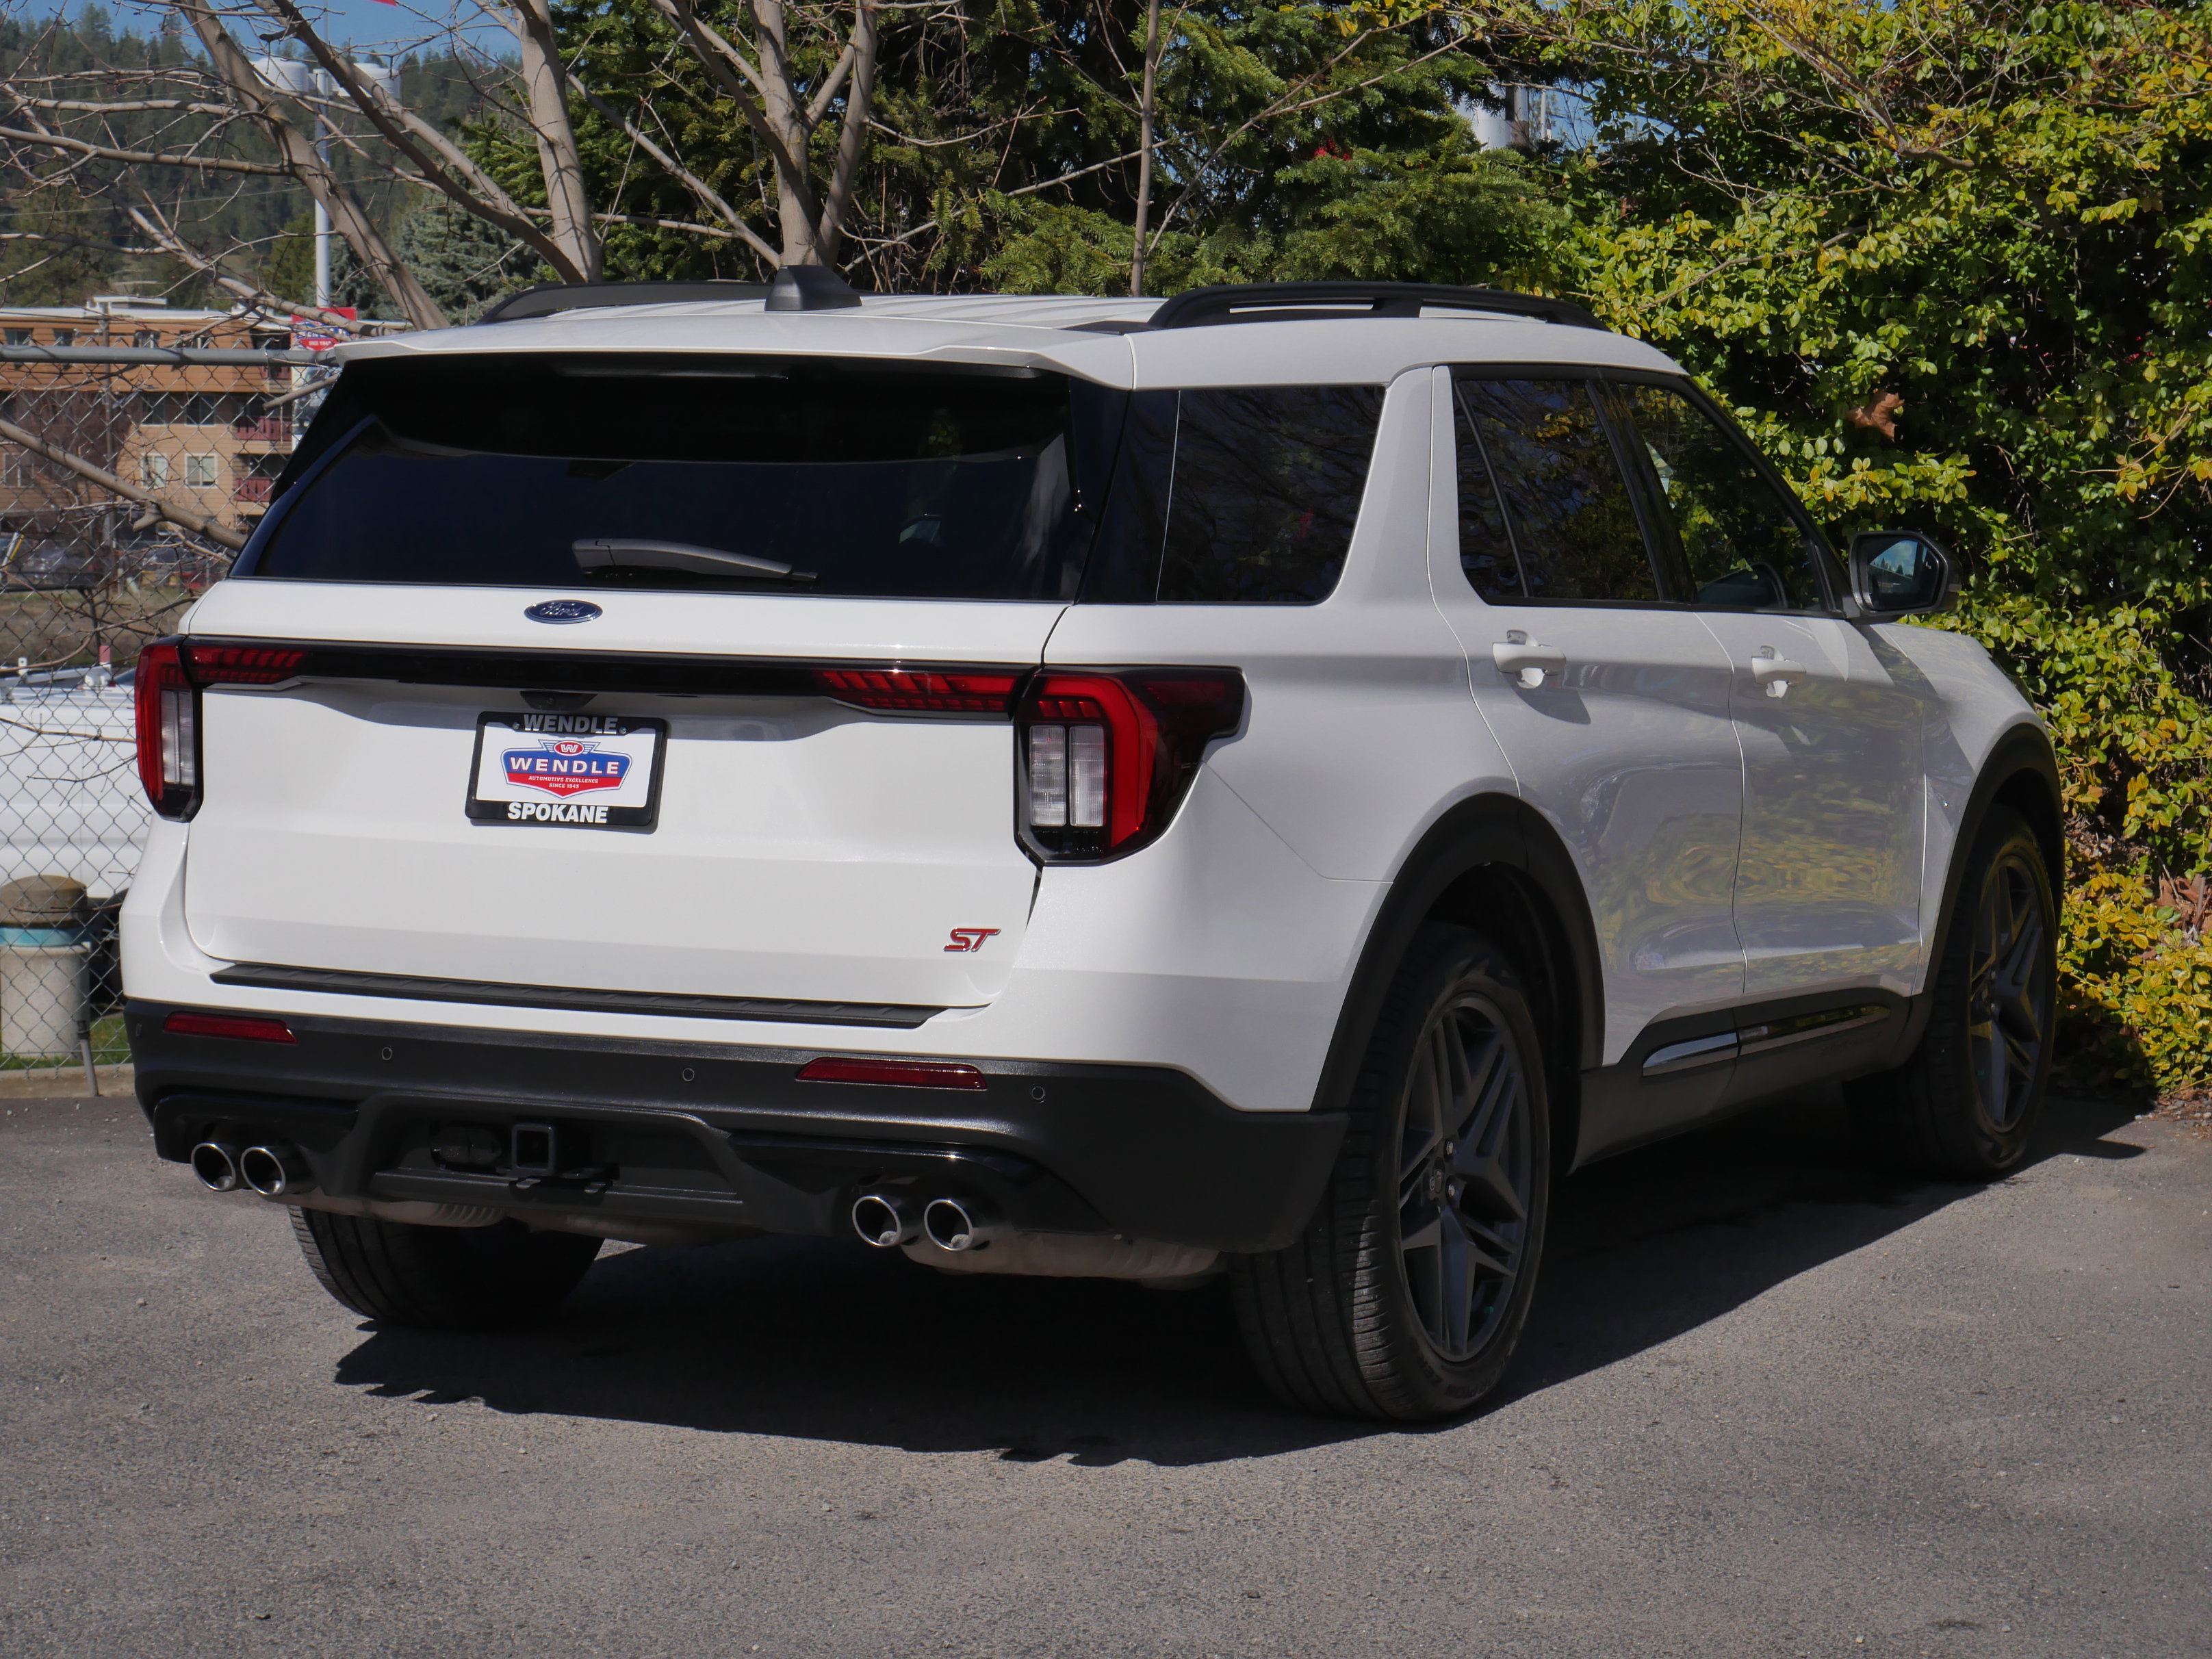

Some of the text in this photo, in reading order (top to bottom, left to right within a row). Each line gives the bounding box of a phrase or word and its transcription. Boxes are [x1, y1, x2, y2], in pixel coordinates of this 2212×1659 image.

[539, 602, 584, 616] Ford
[524, 714, 618, 734] WENDLE
[561, 743, 579, 753] W
[510, 757, 619, 775] WENDLE
[507, 802, 609, 824] SPOKANE
[943, 928, 1001, 952] ST
